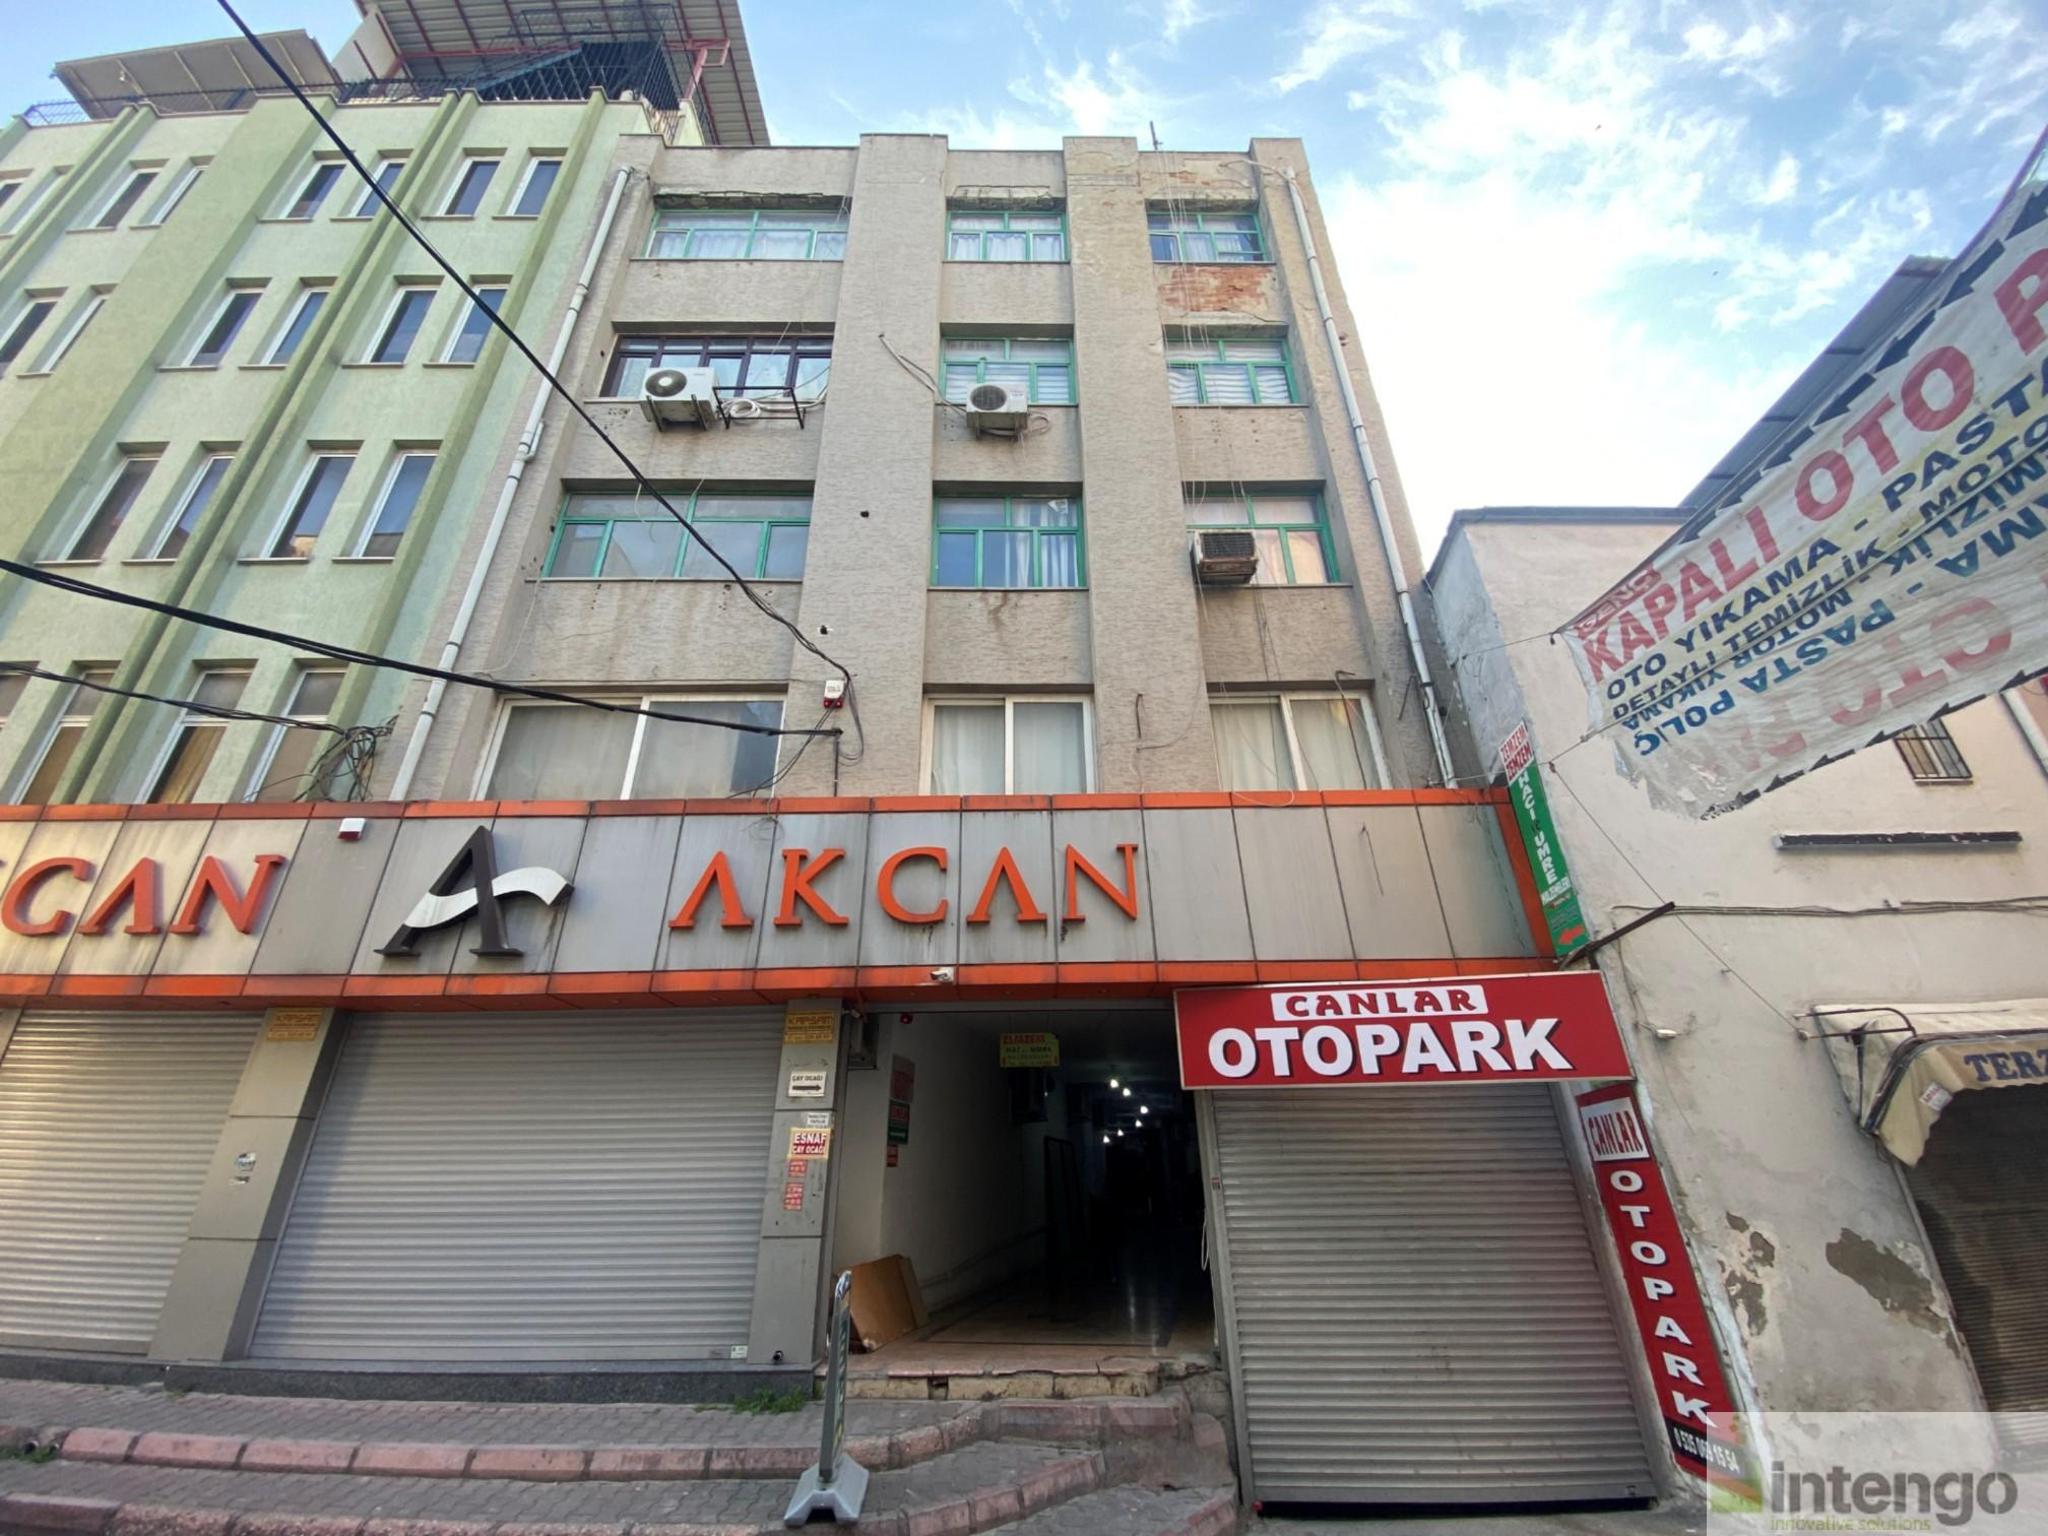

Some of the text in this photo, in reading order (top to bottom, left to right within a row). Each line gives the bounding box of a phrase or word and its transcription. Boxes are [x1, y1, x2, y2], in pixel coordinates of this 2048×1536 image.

[1583, 506, 1780, 683] KAPALI
[1795, 345, 1974, 521] OTO
[1607, 653, 1666, 699] OTO
[1675, 537, 1841, 653] YIKAMA
[1881, 355, 2048, 512] PAST
[1935, 493, 2048, 577] MA
[1723, 537, 1886, 653] TEMİZLİK
[1739, 599, 1895, 693] PASTA
[1506, 744, 1533, 781] ZEMZEM
[0, 855, 286, 936] CAN
[668, 843, 1139, 929] AKCAN
[1534, 831, 1559, 884] UMRE
[1286, 986, 1478, 1019] CANLAR
[1207, 1018, 1574, 1078] OTOPARK
[794, 1132, 827, 1145] ESNAF
[1588, 1110, 1643, 1156] CANLAR
[1609, 1168, 1718, 1428] OTOPARK
